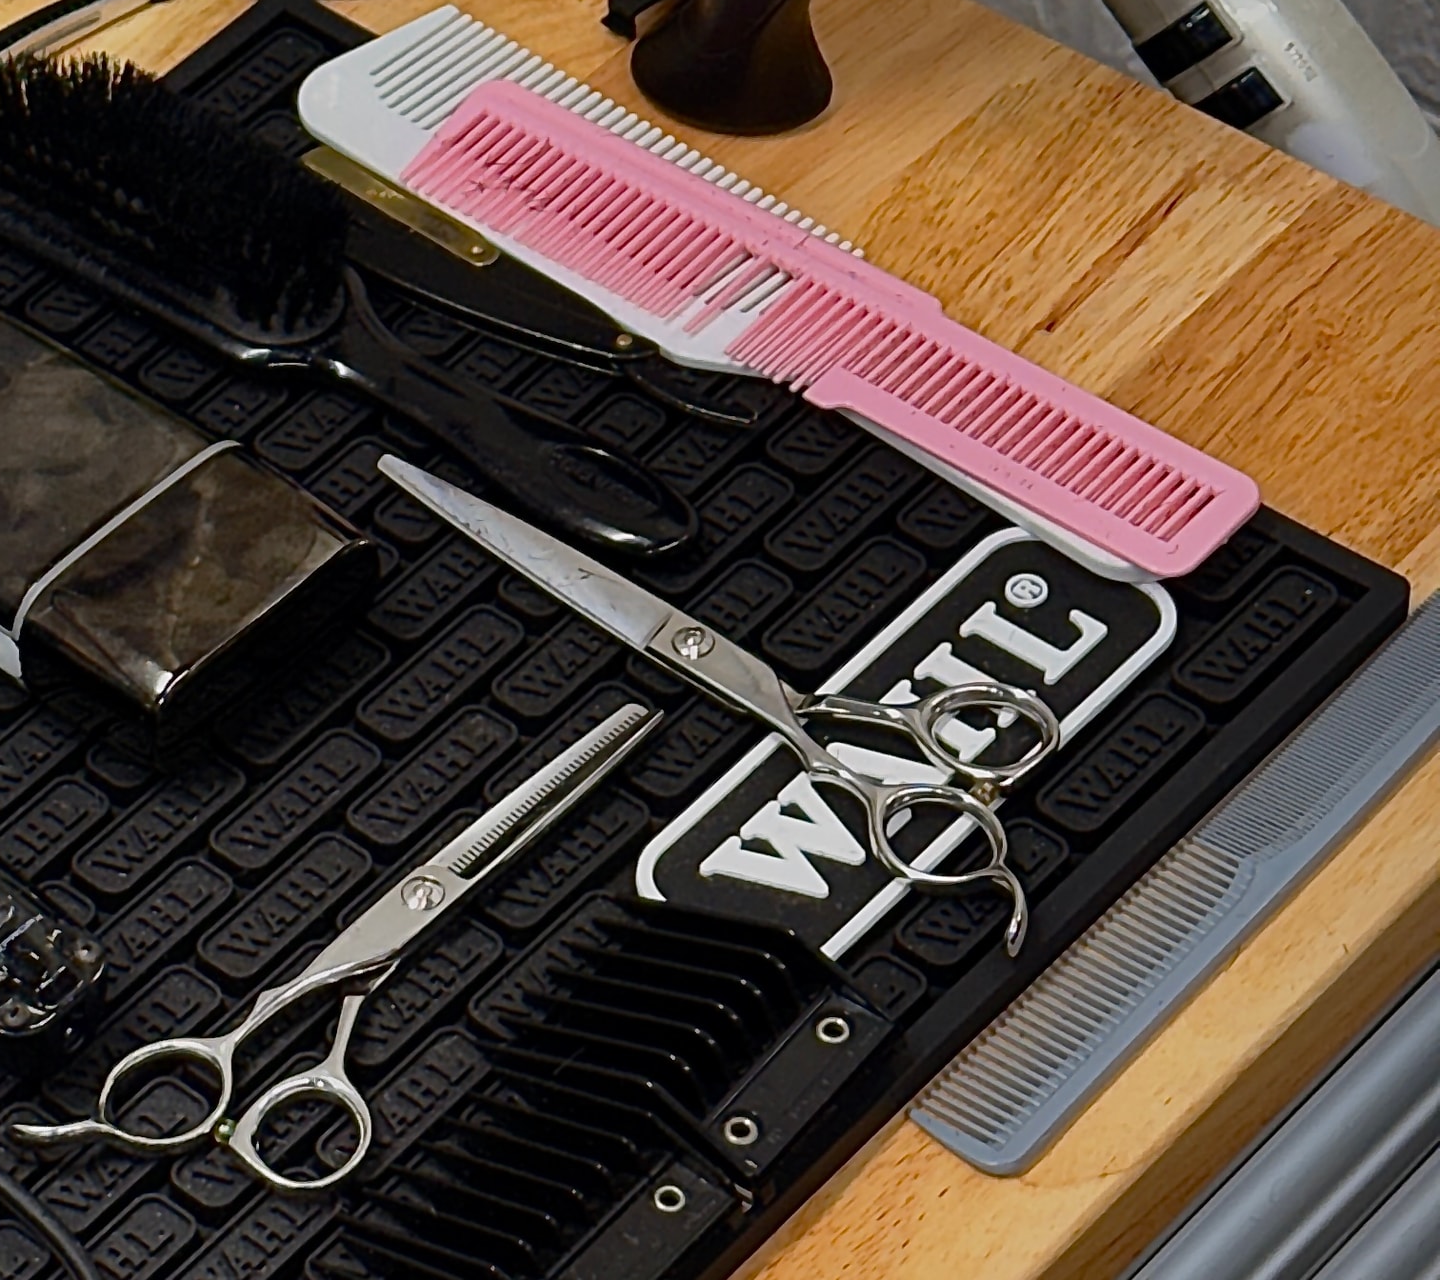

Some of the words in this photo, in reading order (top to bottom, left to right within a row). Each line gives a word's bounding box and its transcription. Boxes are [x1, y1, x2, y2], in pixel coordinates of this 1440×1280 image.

[778, 456, 908, 561] WAHL
[777, 552, 909, 661] WAHL
[1187, 582, 1318, 693] WAHL
[372, 621, 507, 732] WAHL
[226, 745, 365, 860] WAHL
[363, 722, 501, 837] WAHL
[1054, 707, 1188, 824] WAHL
[88, 769, 228, 884] WAHL
[495, 803, 634, 921] WAHL
[214, 851, 356, 970] WAHL
